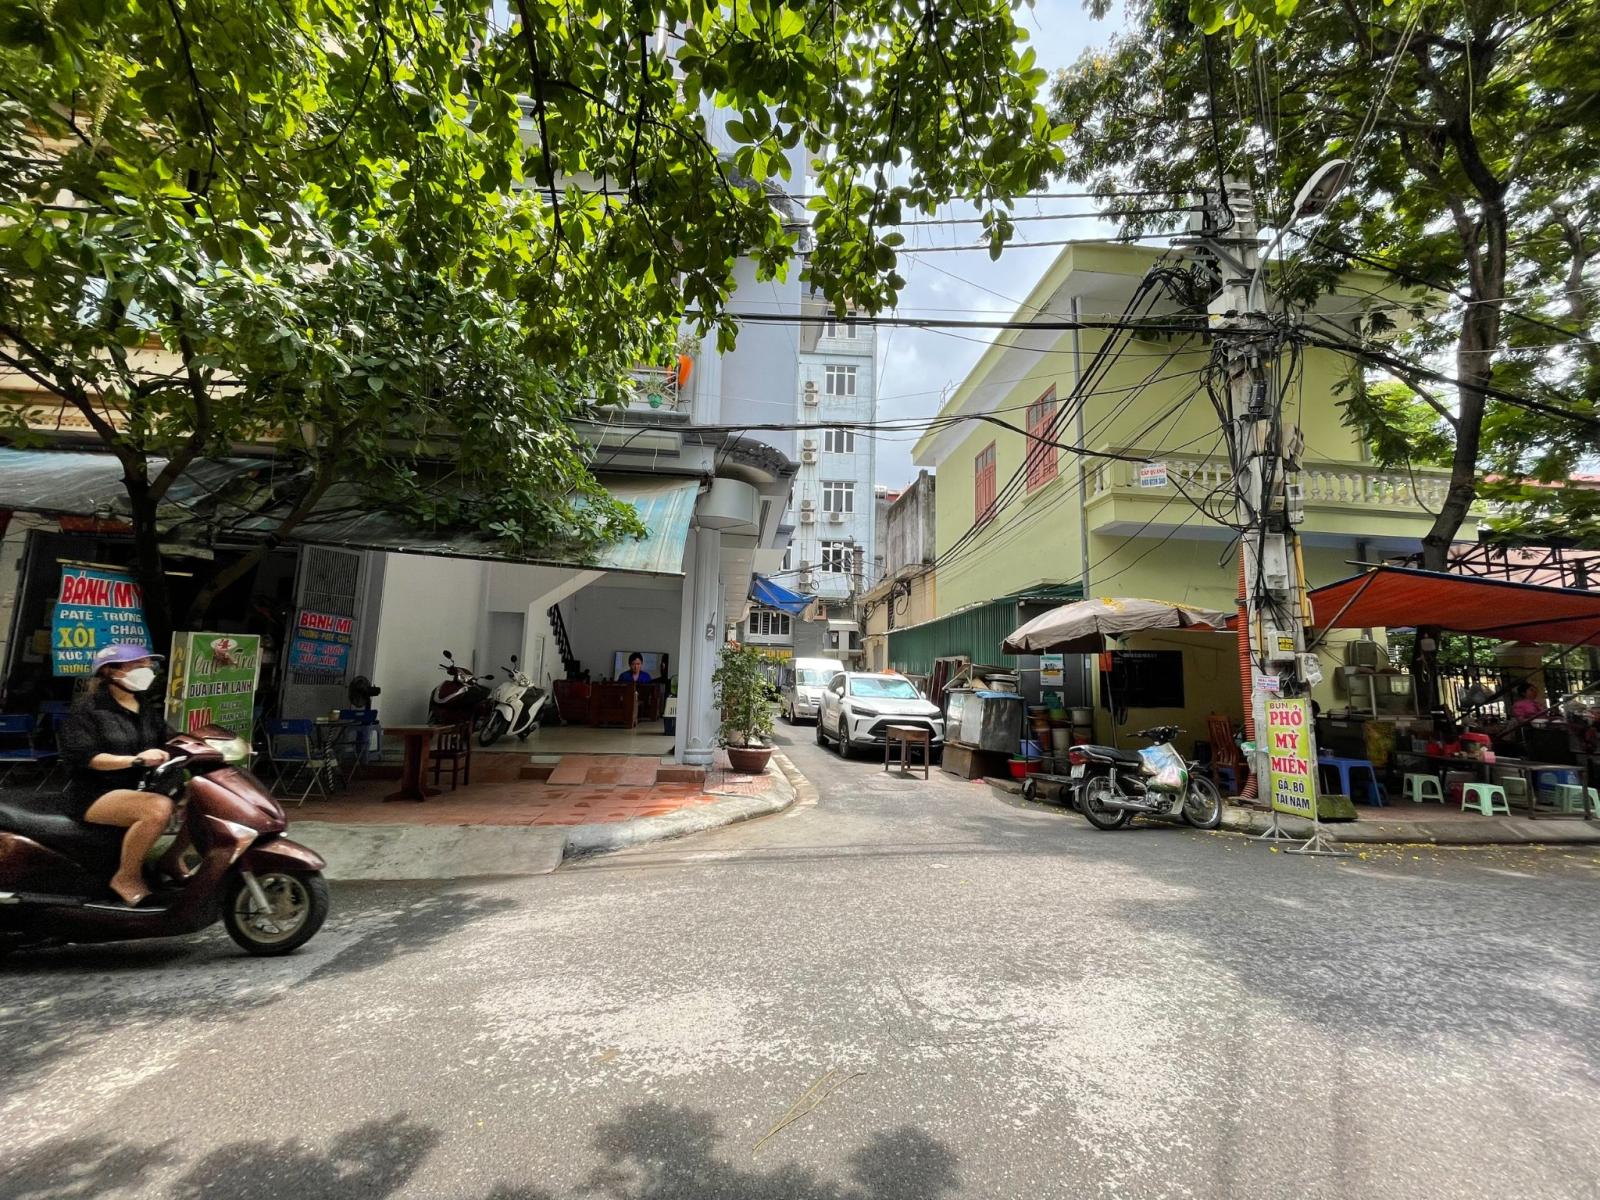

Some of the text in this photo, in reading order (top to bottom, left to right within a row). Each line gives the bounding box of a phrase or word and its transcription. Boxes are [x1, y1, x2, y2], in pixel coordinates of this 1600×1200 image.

[58, 621, 95, 648] XÔI
[707, 627, 714, 636] 2
[1270, 704, 1303, 726] PHỞ
